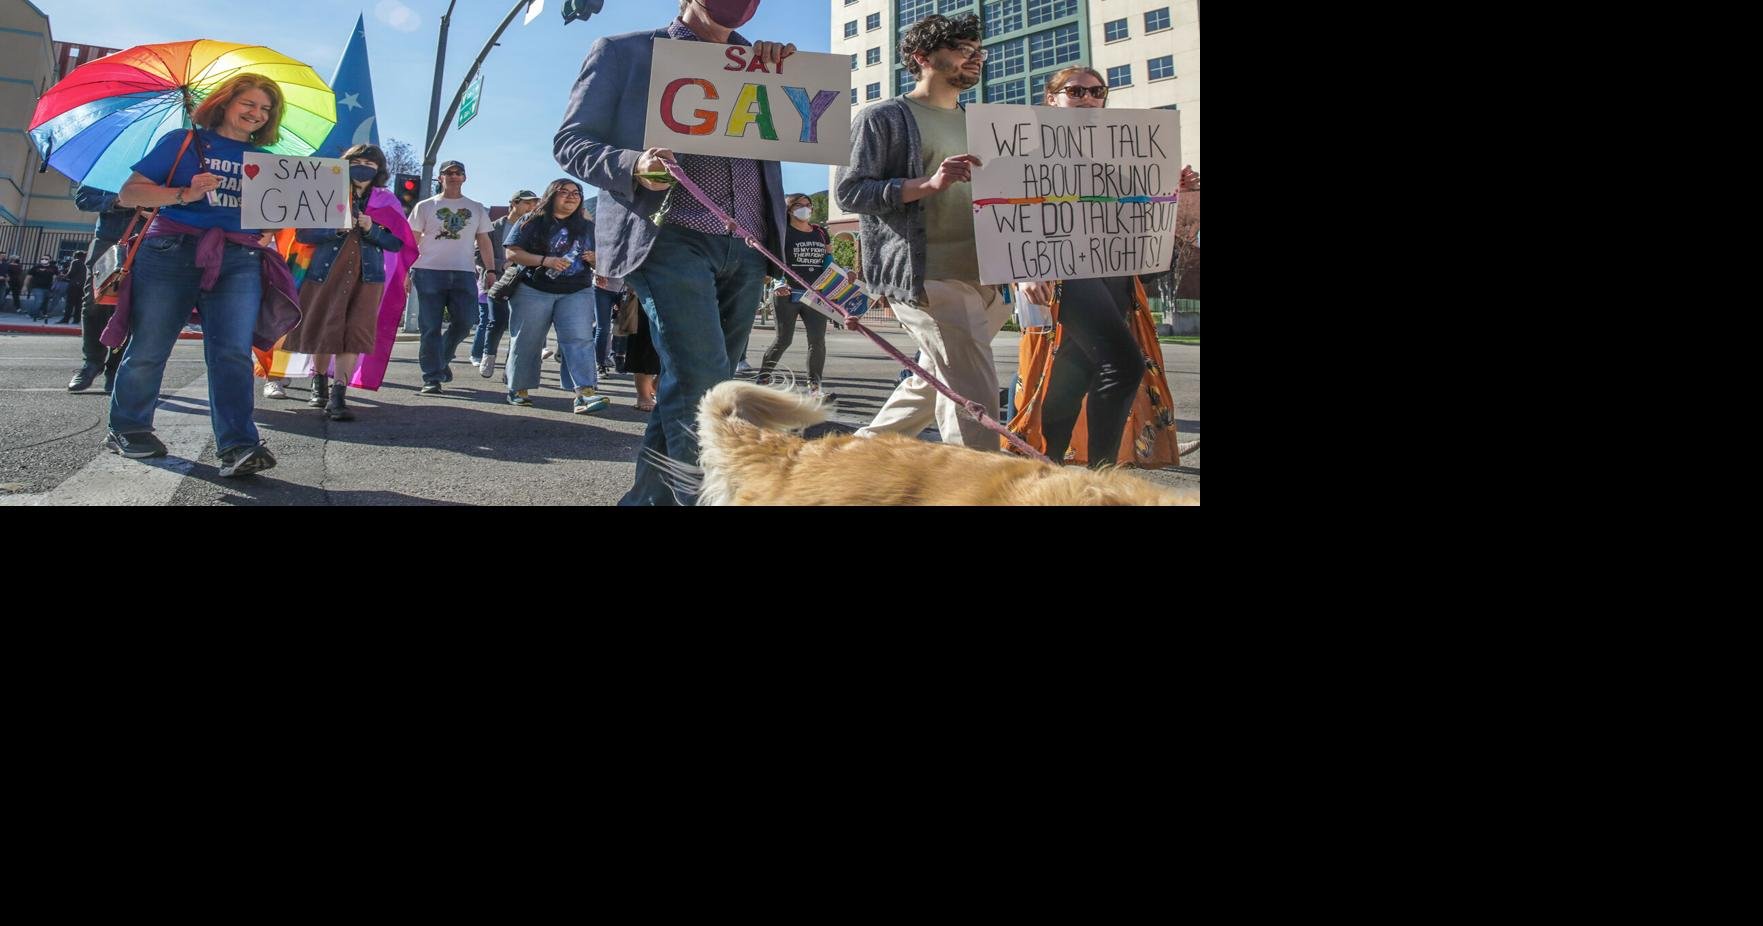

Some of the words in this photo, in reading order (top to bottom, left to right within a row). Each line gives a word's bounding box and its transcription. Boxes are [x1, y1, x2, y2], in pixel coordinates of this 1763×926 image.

[660, 77, 840, 144] GAY
[991, 122, 1031, 157] WE
[1041, 123, 1097, 159] DON'T
[1106, 124, 1167, 159] TALK
[199, 157, 243, 175] PROT
[274, 158, 322, 181] SAY
[1022, 163, 1087, 199] ABOUT
[260, 187, 335, 223] GAY
[991, 204, 1033, 233] WE
[1041, 200, 1074, 236] DO
[1077, 200, 1130, 235] TALK
[1130, 201, 1177, 234] ABOUT
[1089, 235, 1163, 274] RIGHTS!
